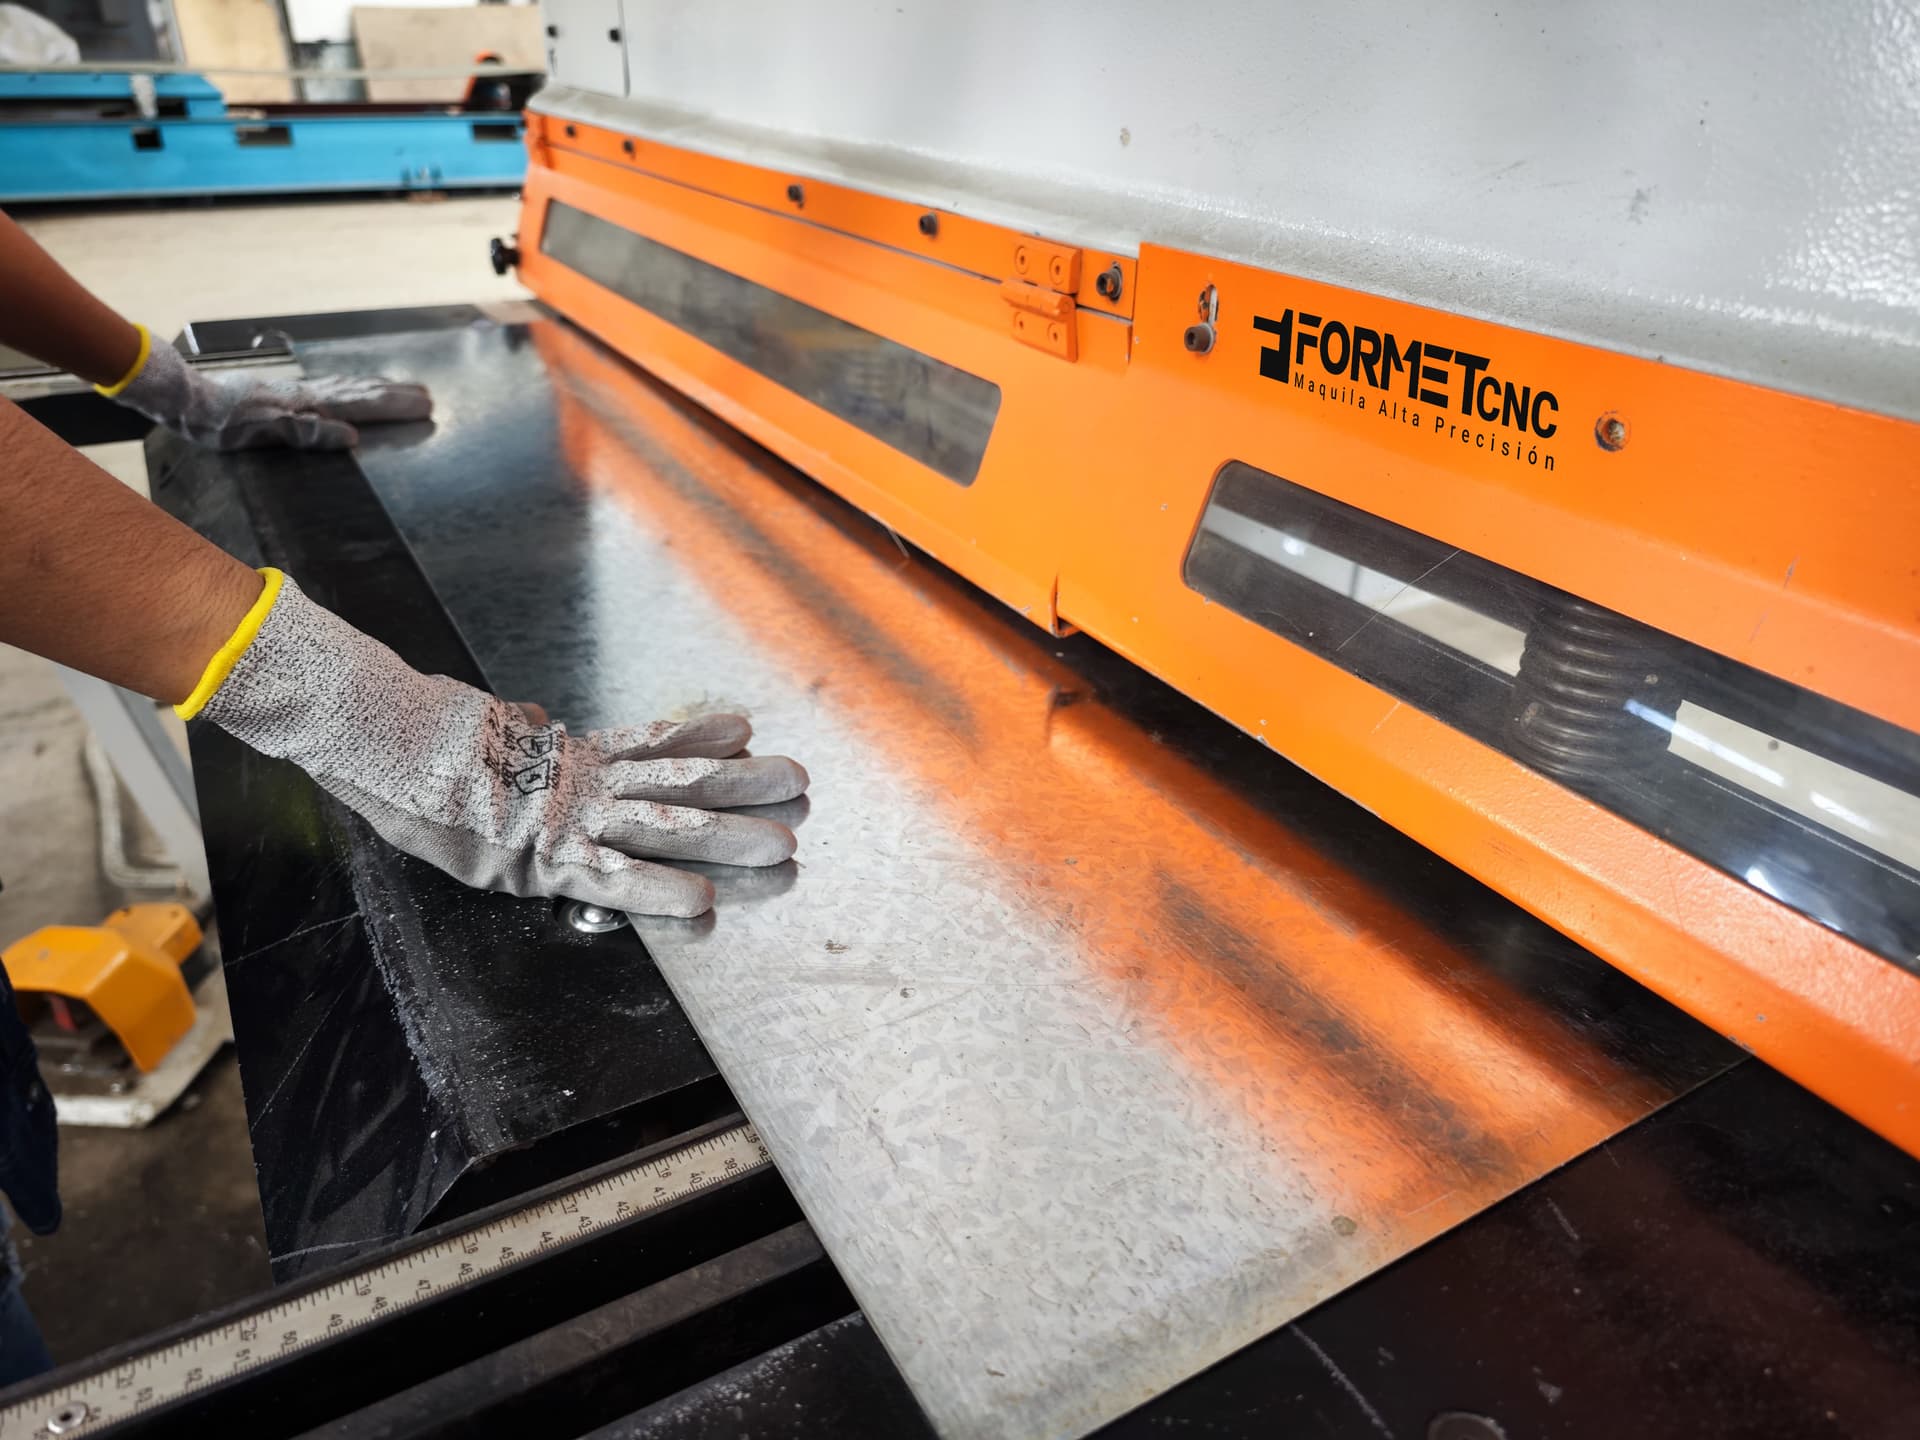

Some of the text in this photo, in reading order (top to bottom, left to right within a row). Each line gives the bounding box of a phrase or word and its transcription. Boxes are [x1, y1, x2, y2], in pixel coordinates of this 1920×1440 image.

[1294, 372, 1555, 471] Maquila Alta Precisión
[749, 1133, 760, 1143] 15
[724, 1157, 738, 1170] 39
[661, 1168, 673, 1178] 16
[690, 1172, 703, 1184] 40
[654, 1186, 667, 1198] 41
[567, 1203, 579, 1214] 17
[618, 1201, 630, 1213] 42
[580, 1215, 592, 1228] 43
[541, 1231, 554, 1243] 44
[466, 1242, 479, 1254] 18
[501, 1246, 515, 1259] 45
[460, 1262, 473, 1276] 46
[418, 1280, 431, 1290] 47
[330, 1314, 343, 1327] 49
[283, 1330, 298, 1345] 50
[235, 1348, 250, 1361] 51
